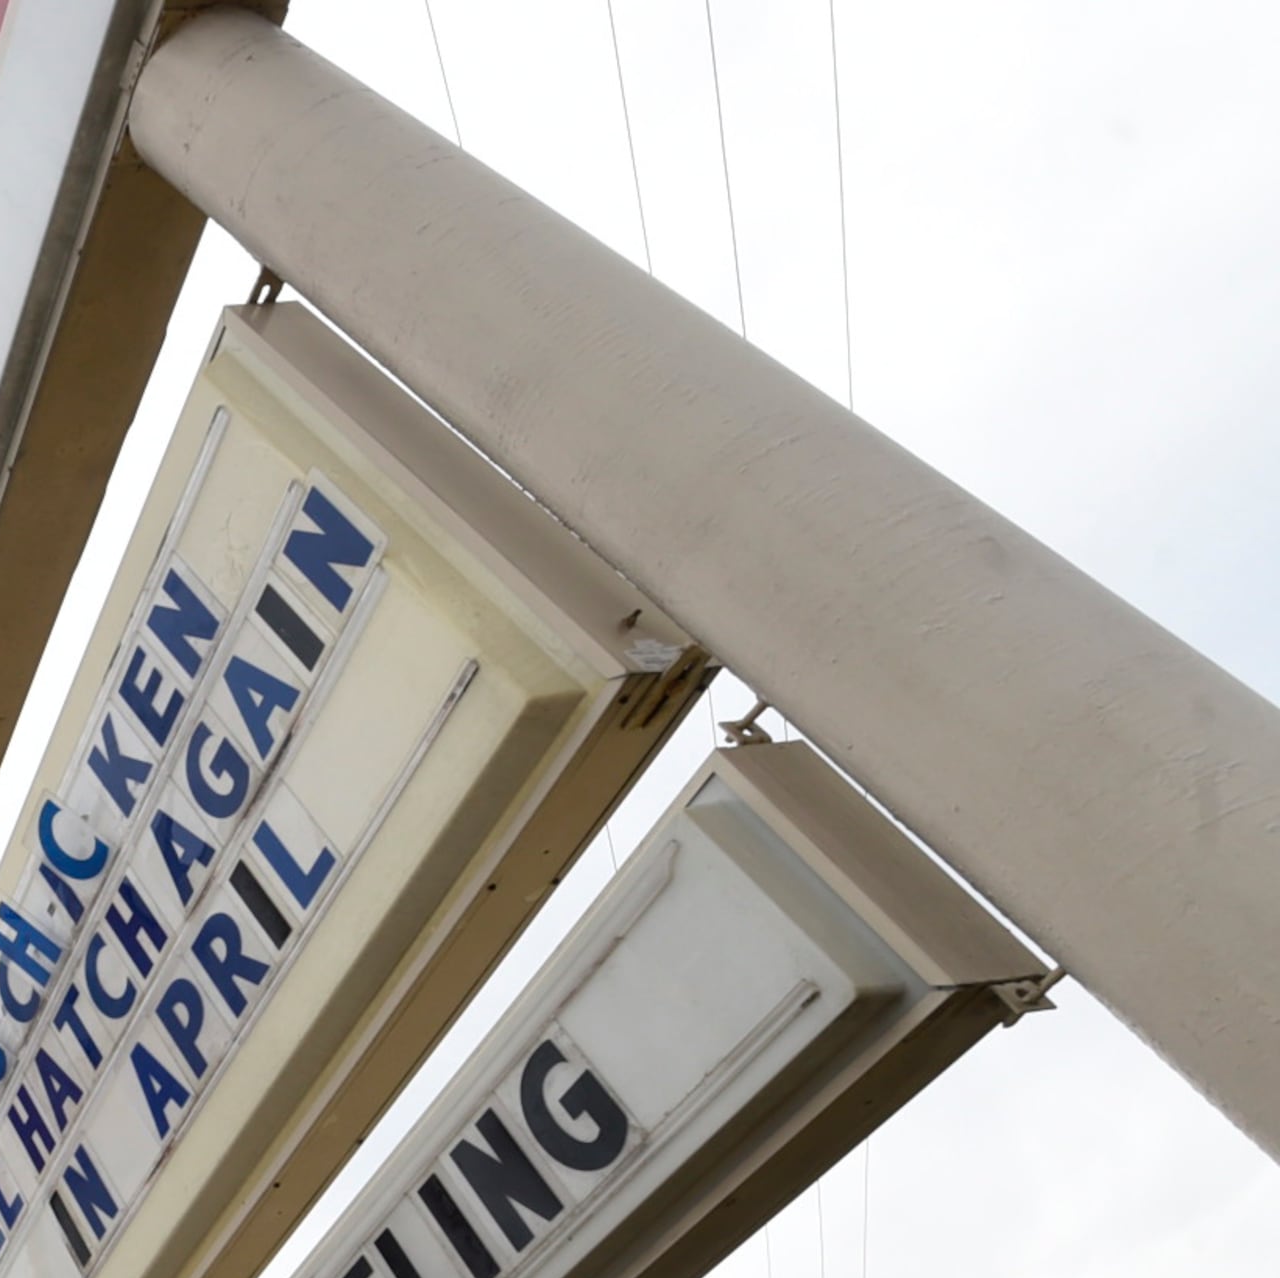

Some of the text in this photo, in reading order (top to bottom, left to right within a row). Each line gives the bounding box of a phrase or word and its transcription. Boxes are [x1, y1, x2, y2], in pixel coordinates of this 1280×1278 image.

[7, 874, 169, 1175] HATCH
[149, 485, 375, 908] AGAIN
[48, 819, 337, 1269] IN APRIL
